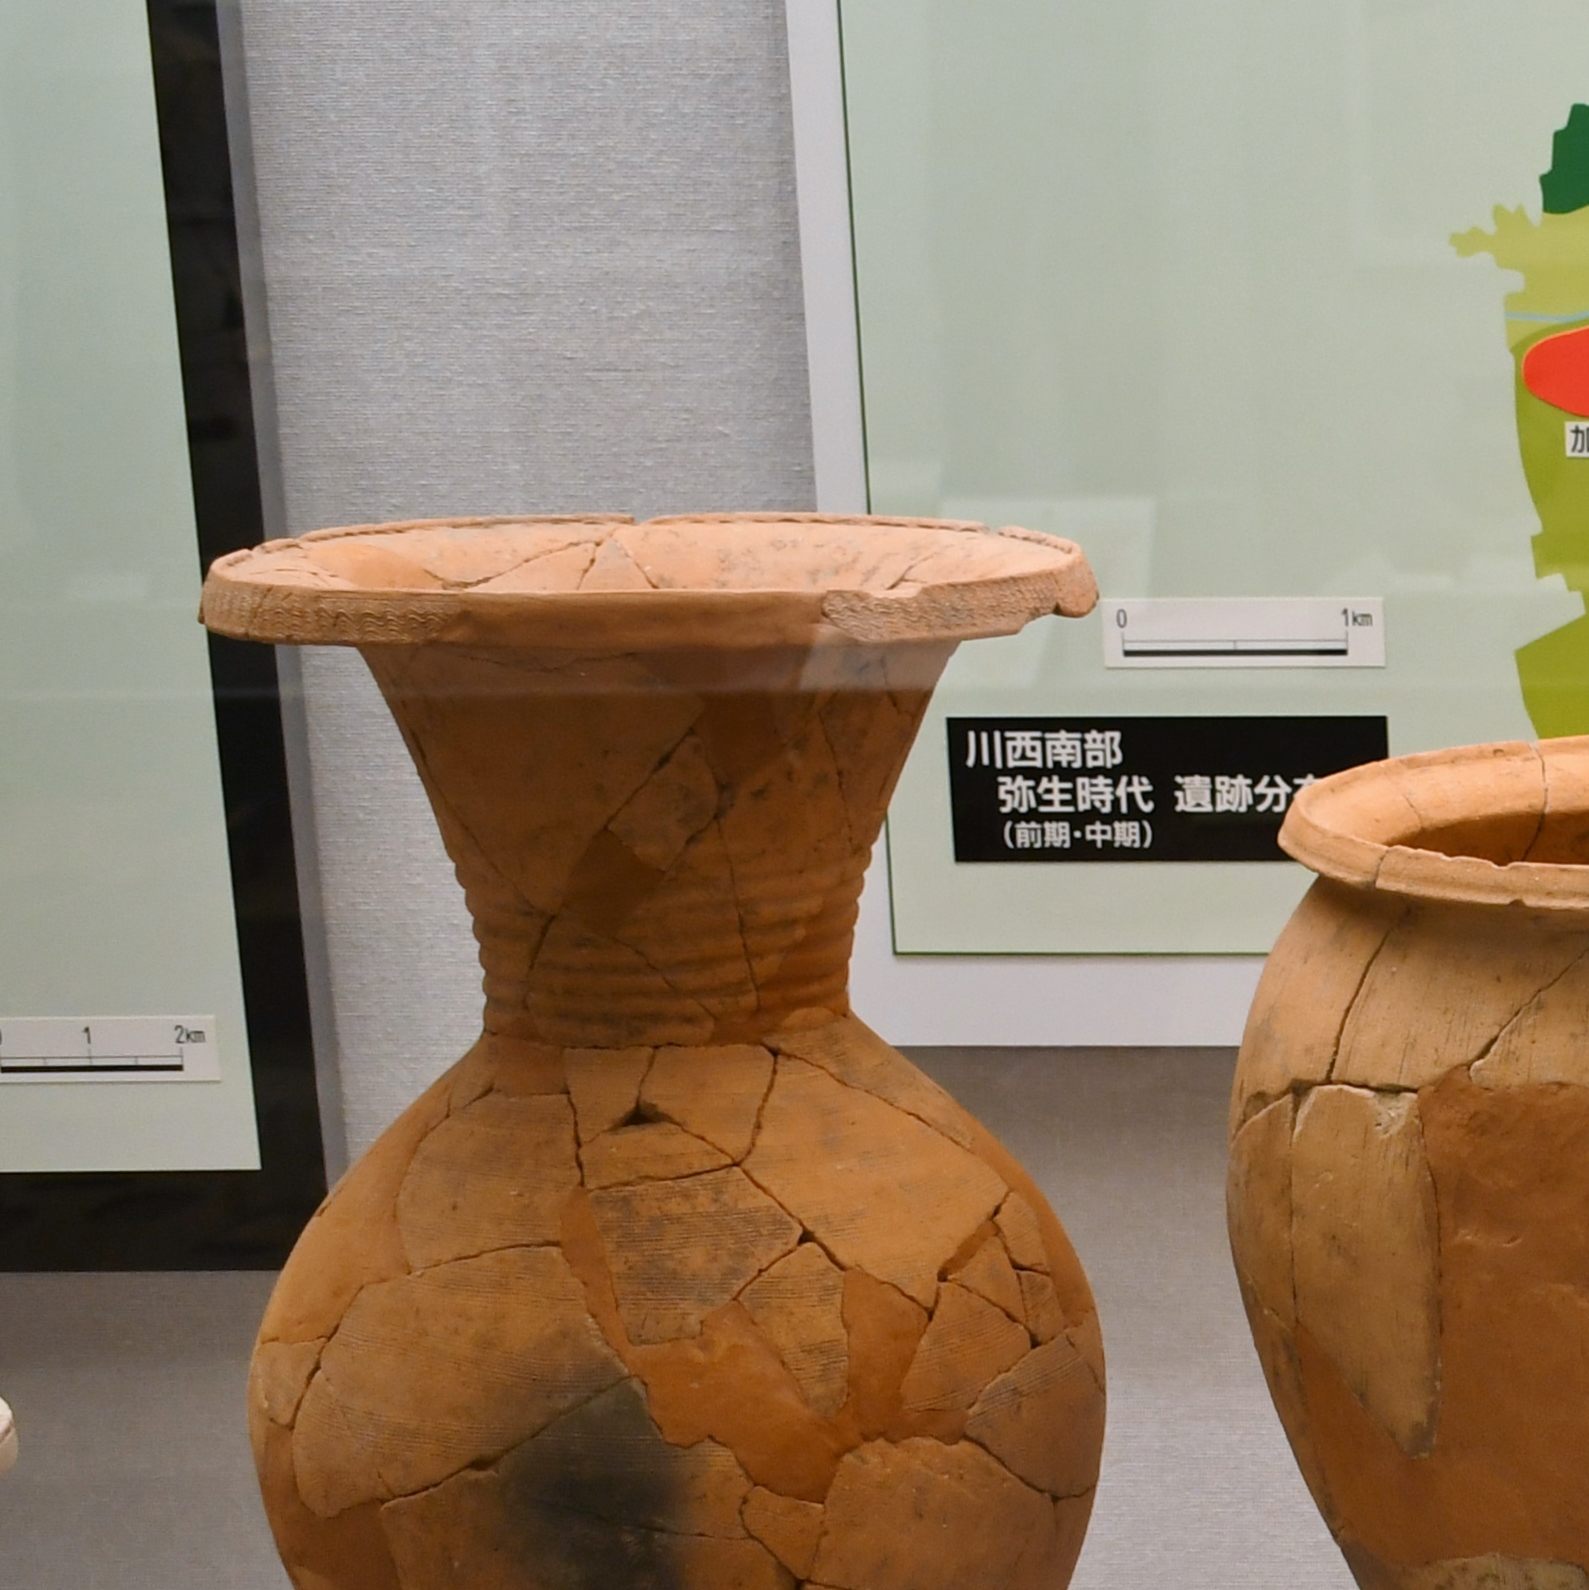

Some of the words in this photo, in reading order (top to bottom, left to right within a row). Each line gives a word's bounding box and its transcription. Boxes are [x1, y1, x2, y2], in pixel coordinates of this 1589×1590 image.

[965, 729, 1123, 769] 川西南部
[996, 774, 1155, 814] 弥生時代
